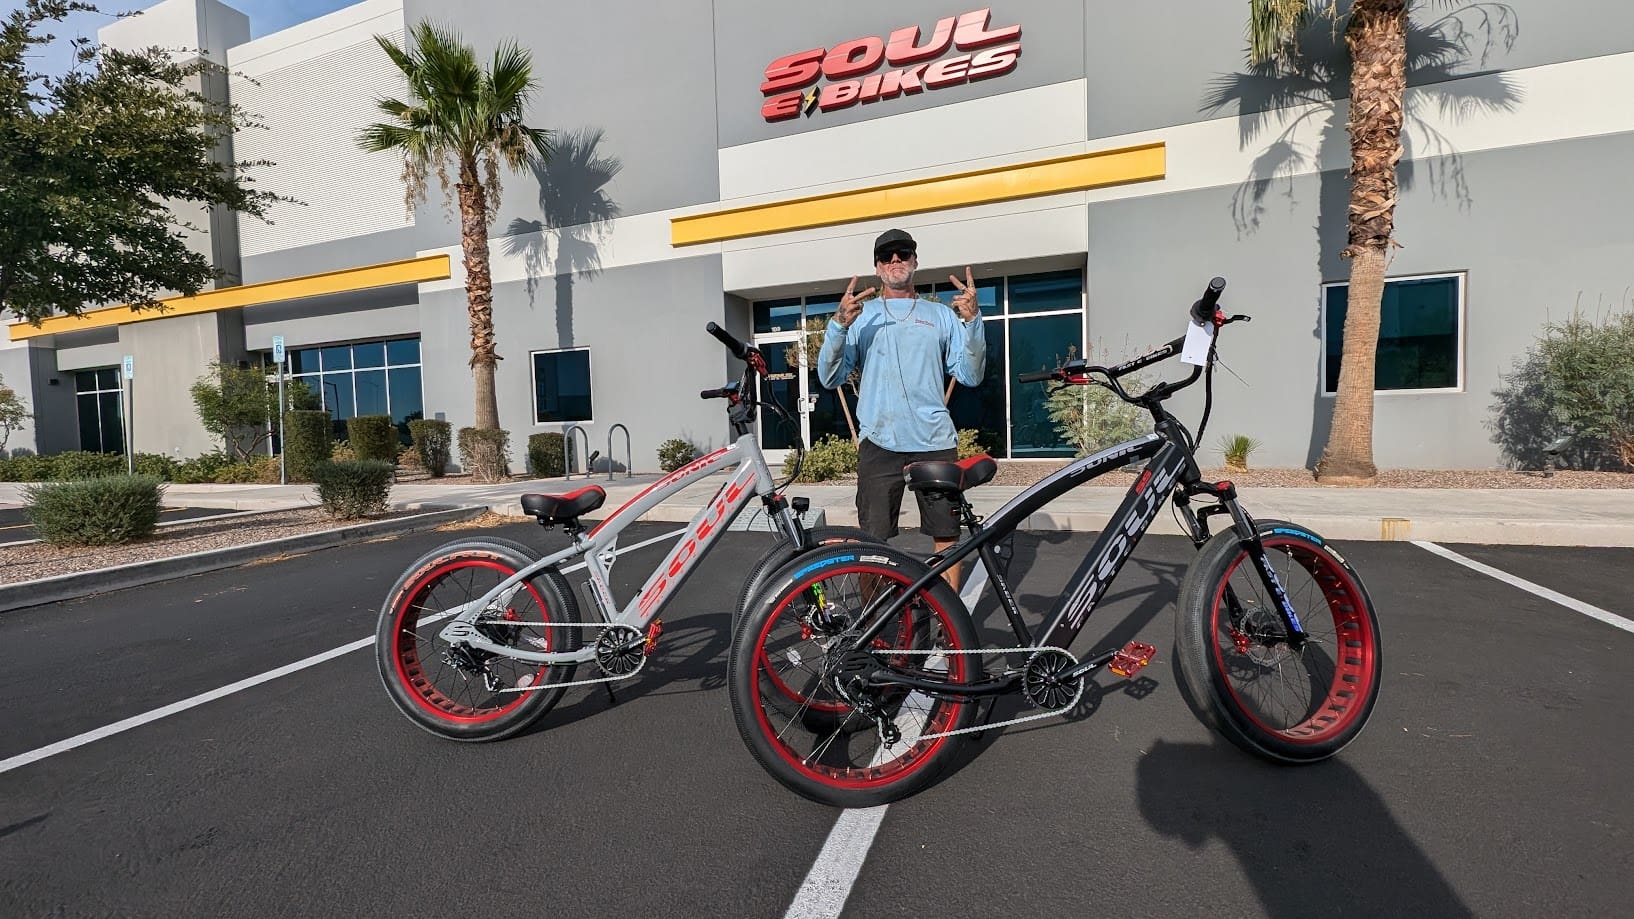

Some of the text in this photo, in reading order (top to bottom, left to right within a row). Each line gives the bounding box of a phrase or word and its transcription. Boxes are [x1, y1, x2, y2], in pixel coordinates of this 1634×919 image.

[760, 7, 1021, 96] SOUL
[638, 472, 756, 618] SOUL
[793, 554, 855, 580] SPEEDSTER
[1067, 456, 1185, 630] SOUL
